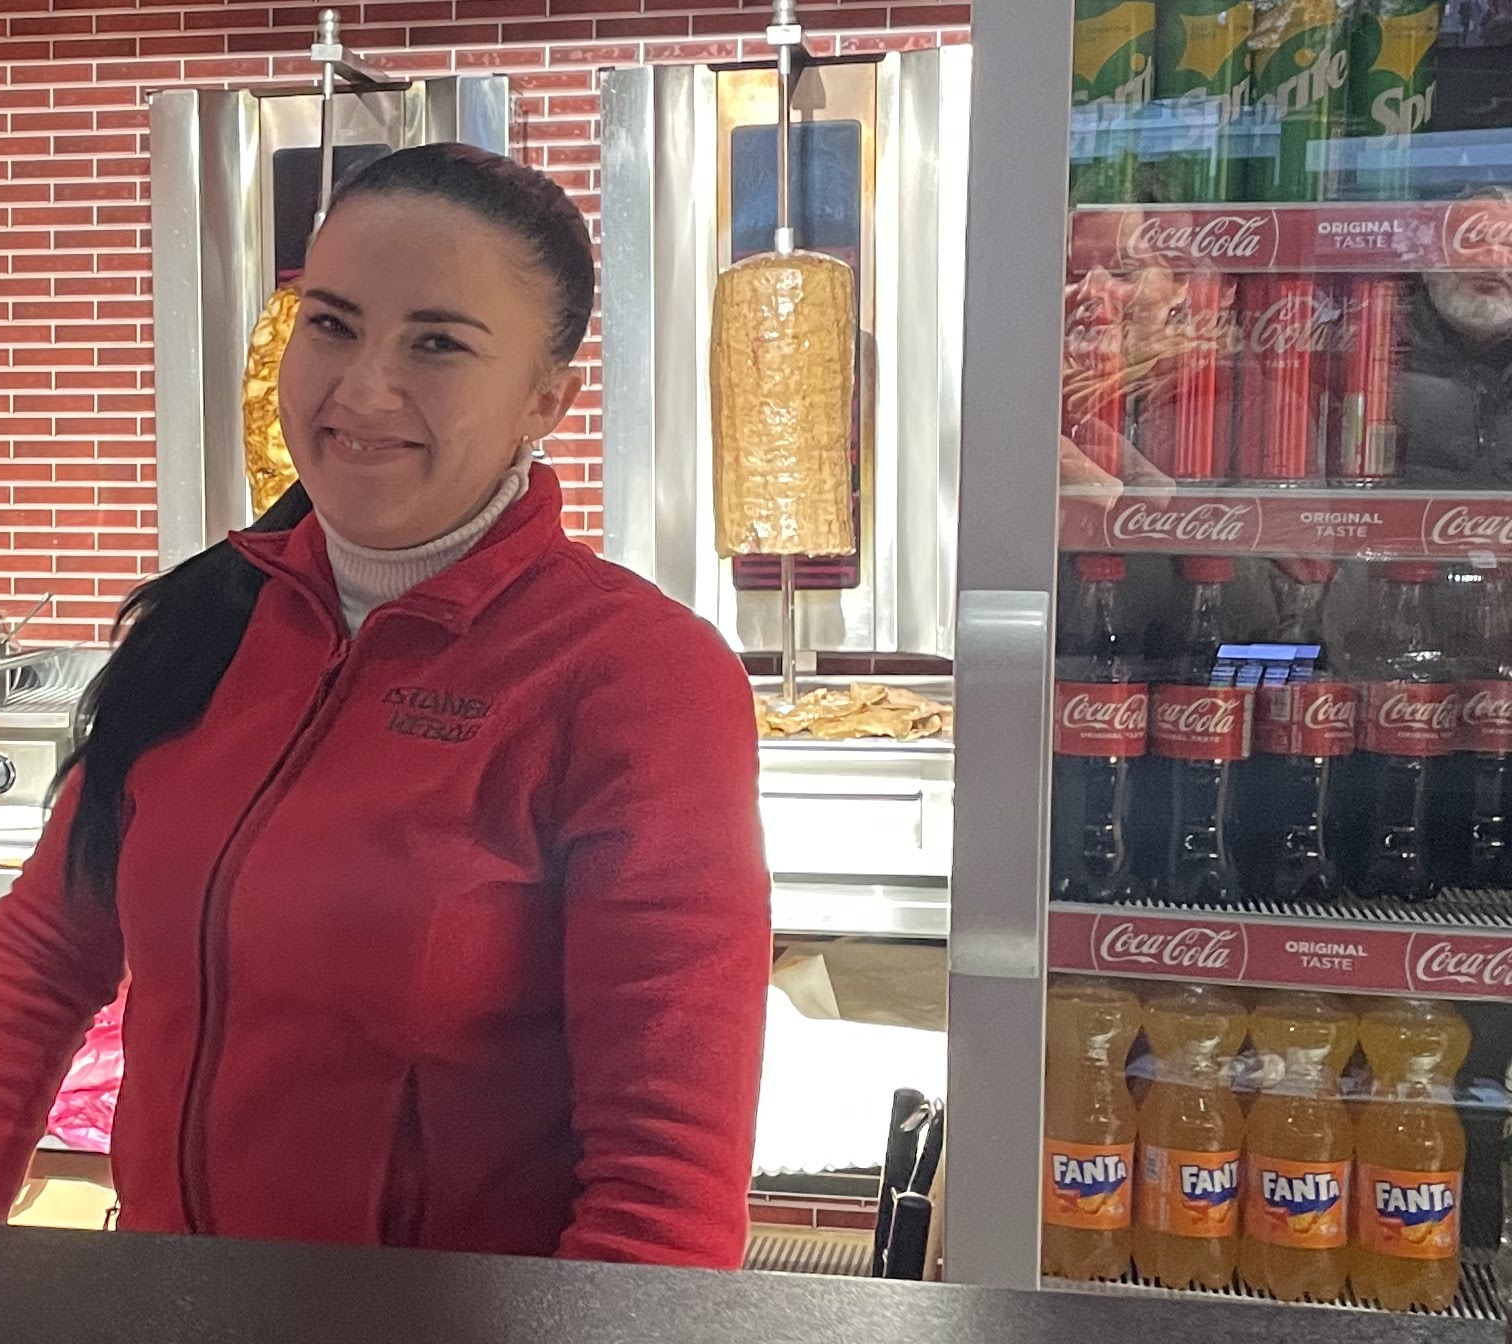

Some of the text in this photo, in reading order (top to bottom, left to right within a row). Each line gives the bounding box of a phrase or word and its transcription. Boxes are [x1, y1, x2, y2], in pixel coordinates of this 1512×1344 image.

[1126, 215, 1271, 259] Coca-Cola
[1317, 219, 1403, 234] ORIGINAL
[1333, 235, 1387, 250] TASTE
[1113, 502, 1253, 541] Coca-Cola
[1299, 511, 1384, 525] ORIGINAL
[1315, 525, 1368, 539] TASTE
[1100, 922, 1238, 969] Coca-Cola
[1285, 940, 1369, 957] ORIGINAL
[1301, 956, 1353, 971] TASTE
[1052, 1155, 1126, 1185] FANTA
[1181, 1161, 1238, 1195] FANT
[1262, 1171, 1339, 1202] FANTA
[1375, 1181, 1454, 1213] FANTA
